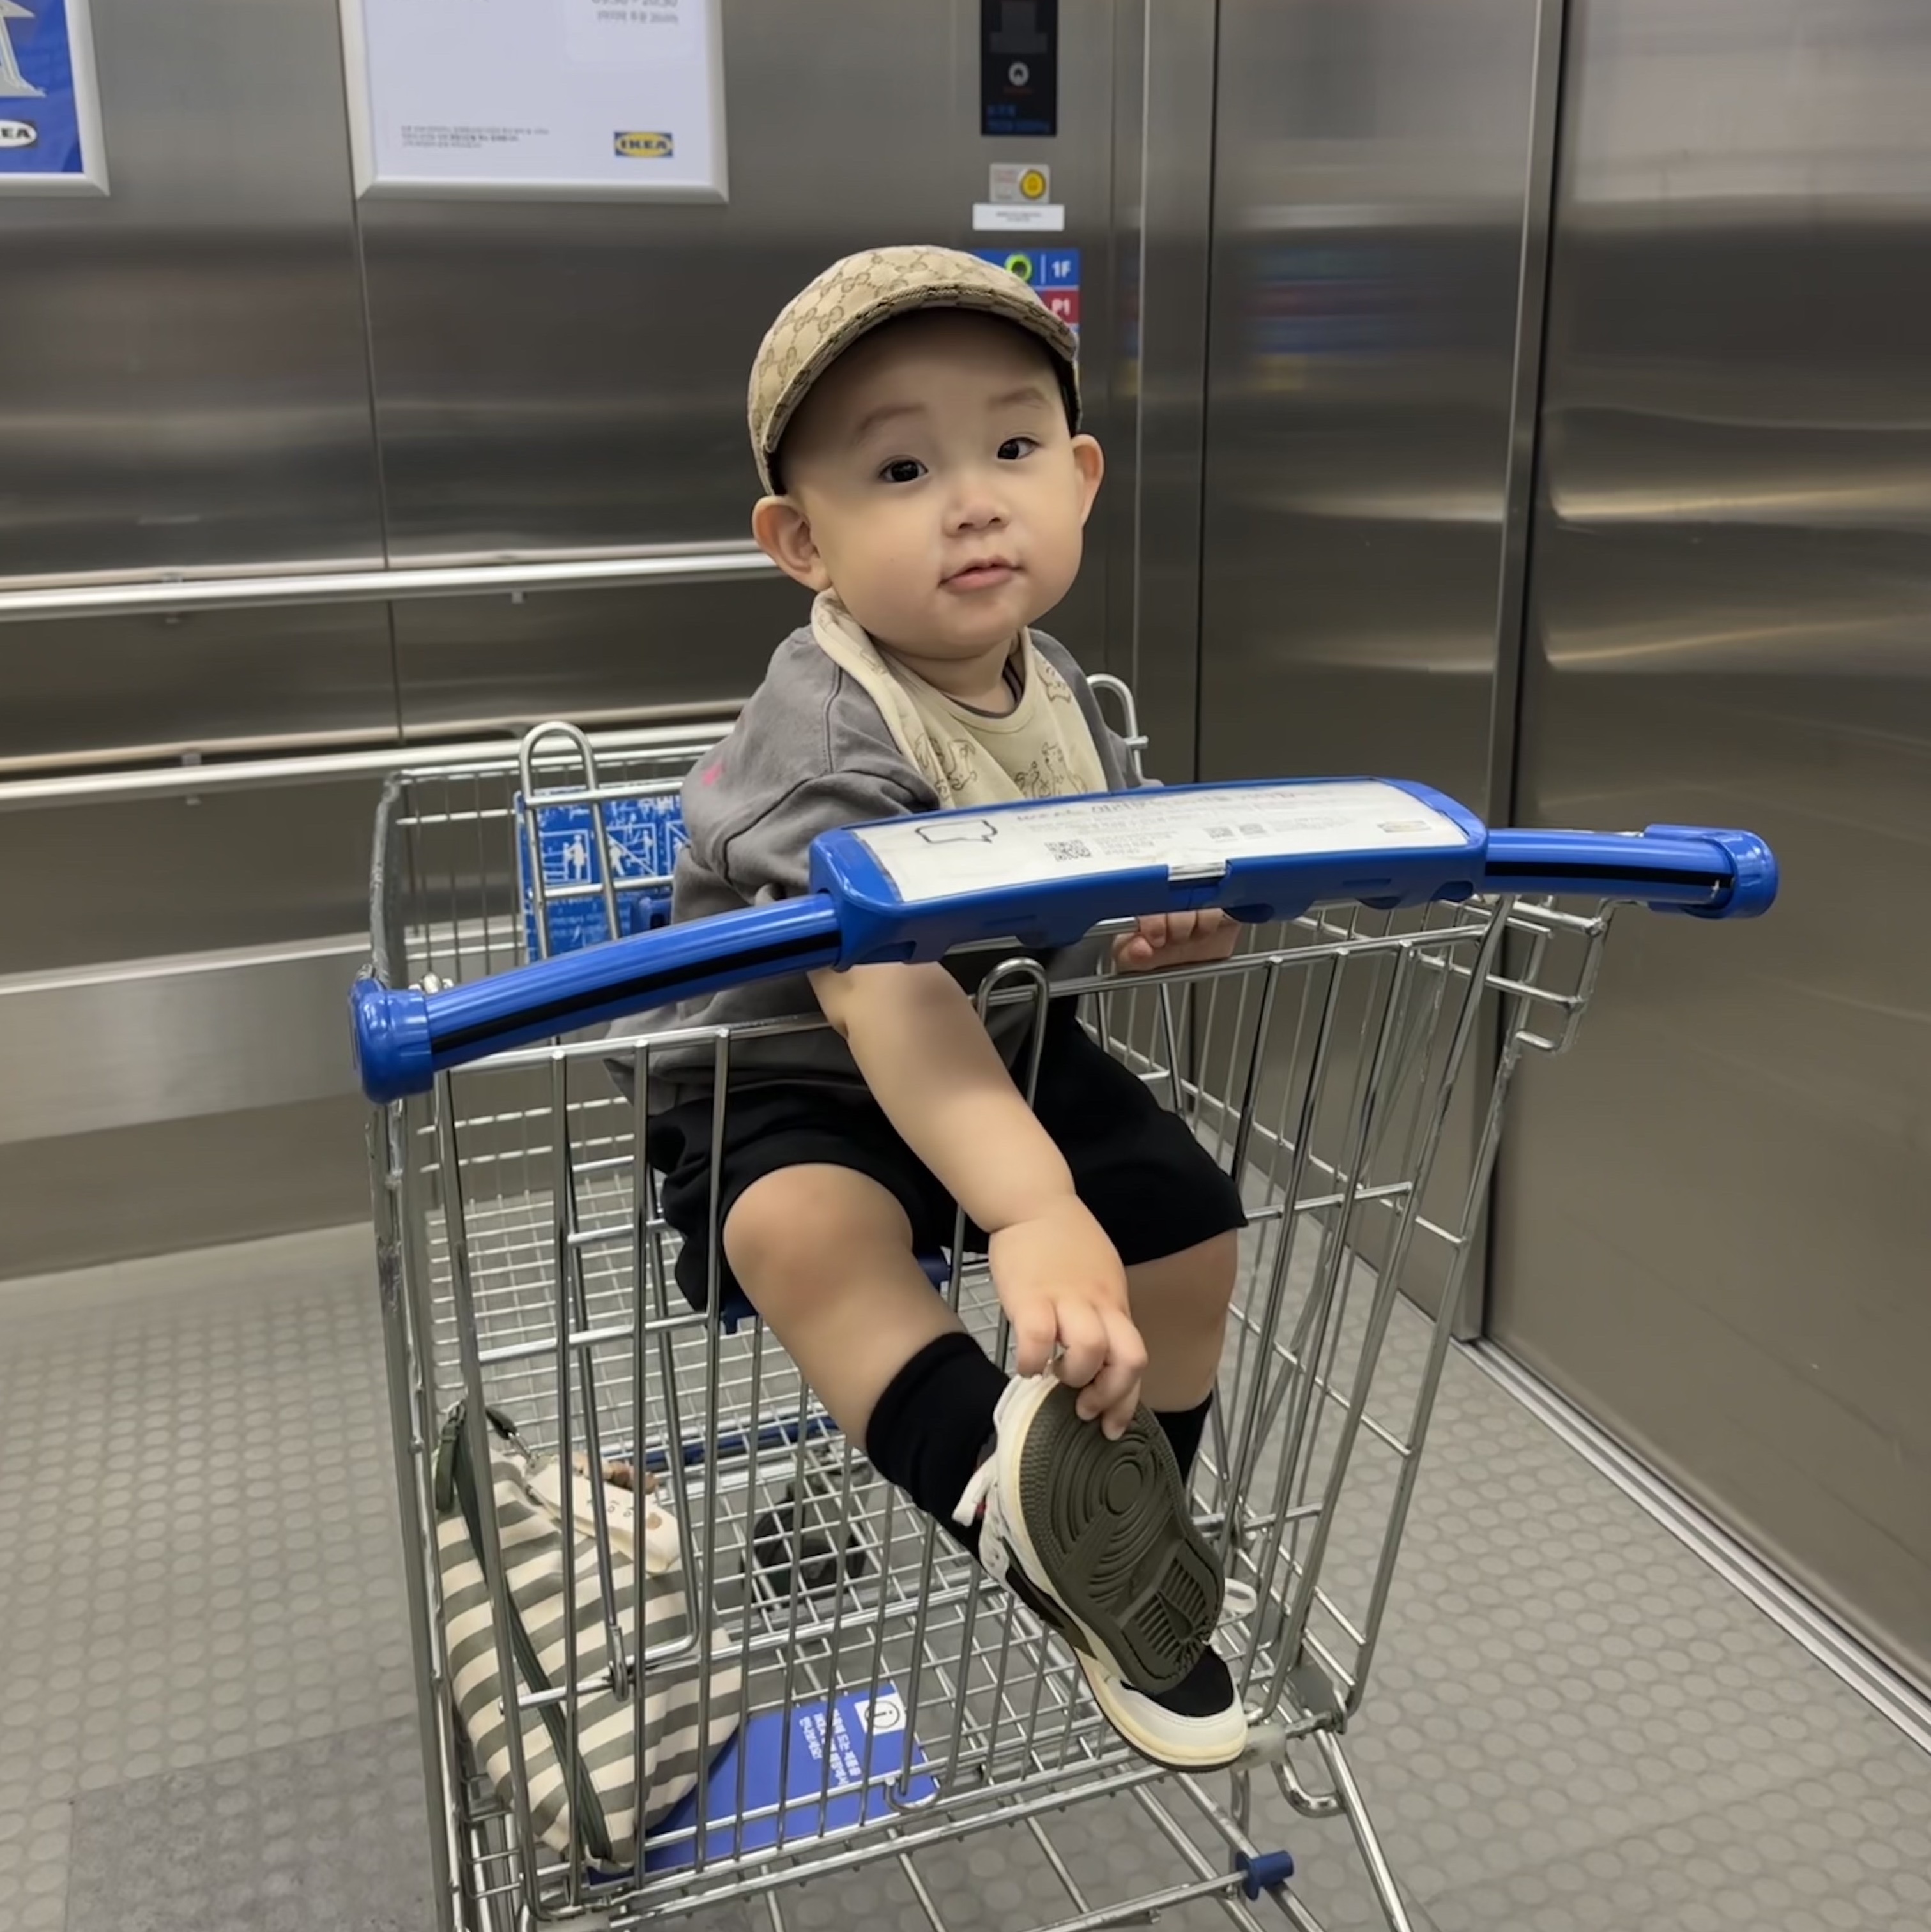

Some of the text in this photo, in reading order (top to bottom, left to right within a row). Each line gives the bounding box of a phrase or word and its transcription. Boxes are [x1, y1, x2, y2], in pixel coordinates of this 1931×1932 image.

[1, 128, 31, 139] EA
[621, 139, 667, 150] IKEA
[1051, 260, 1071, 278] 1F
